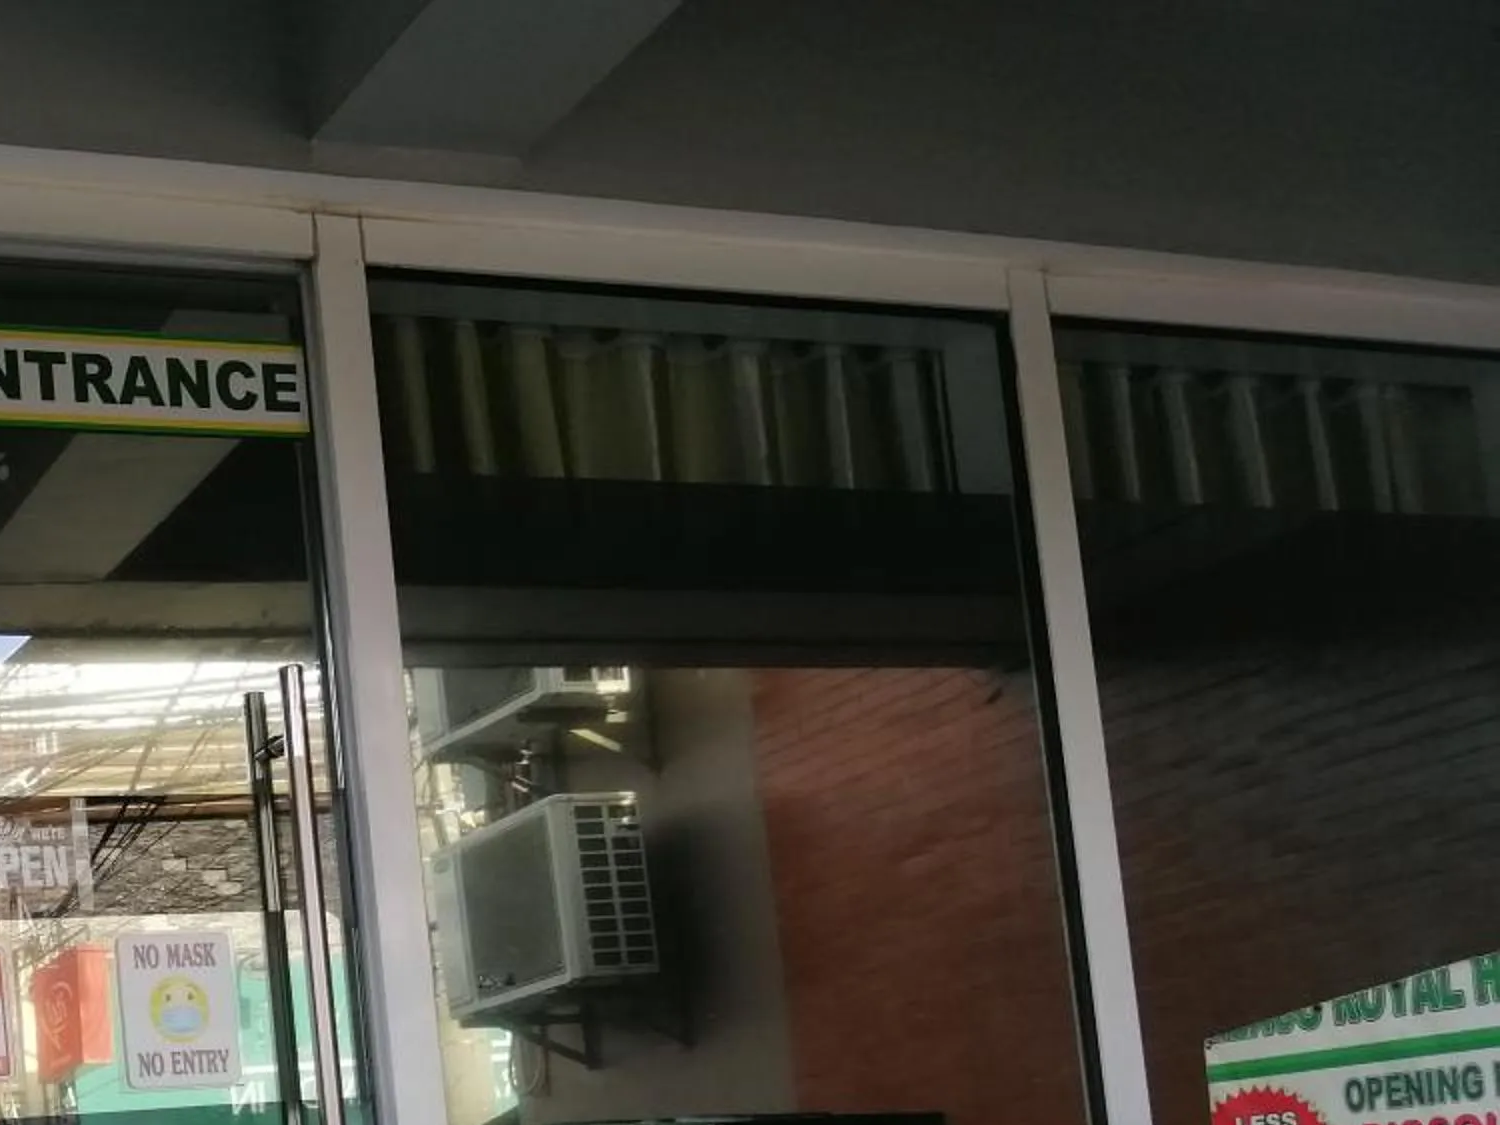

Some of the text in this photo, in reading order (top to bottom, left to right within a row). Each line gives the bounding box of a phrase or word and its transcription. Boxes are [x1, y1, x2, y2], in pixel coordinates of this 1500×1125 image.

[132, 942, 217, 969] NO MASK
[137, 1047, 230, 1079] NO ENTRY
[1345, 1061, 1485, 1114] OPENING
